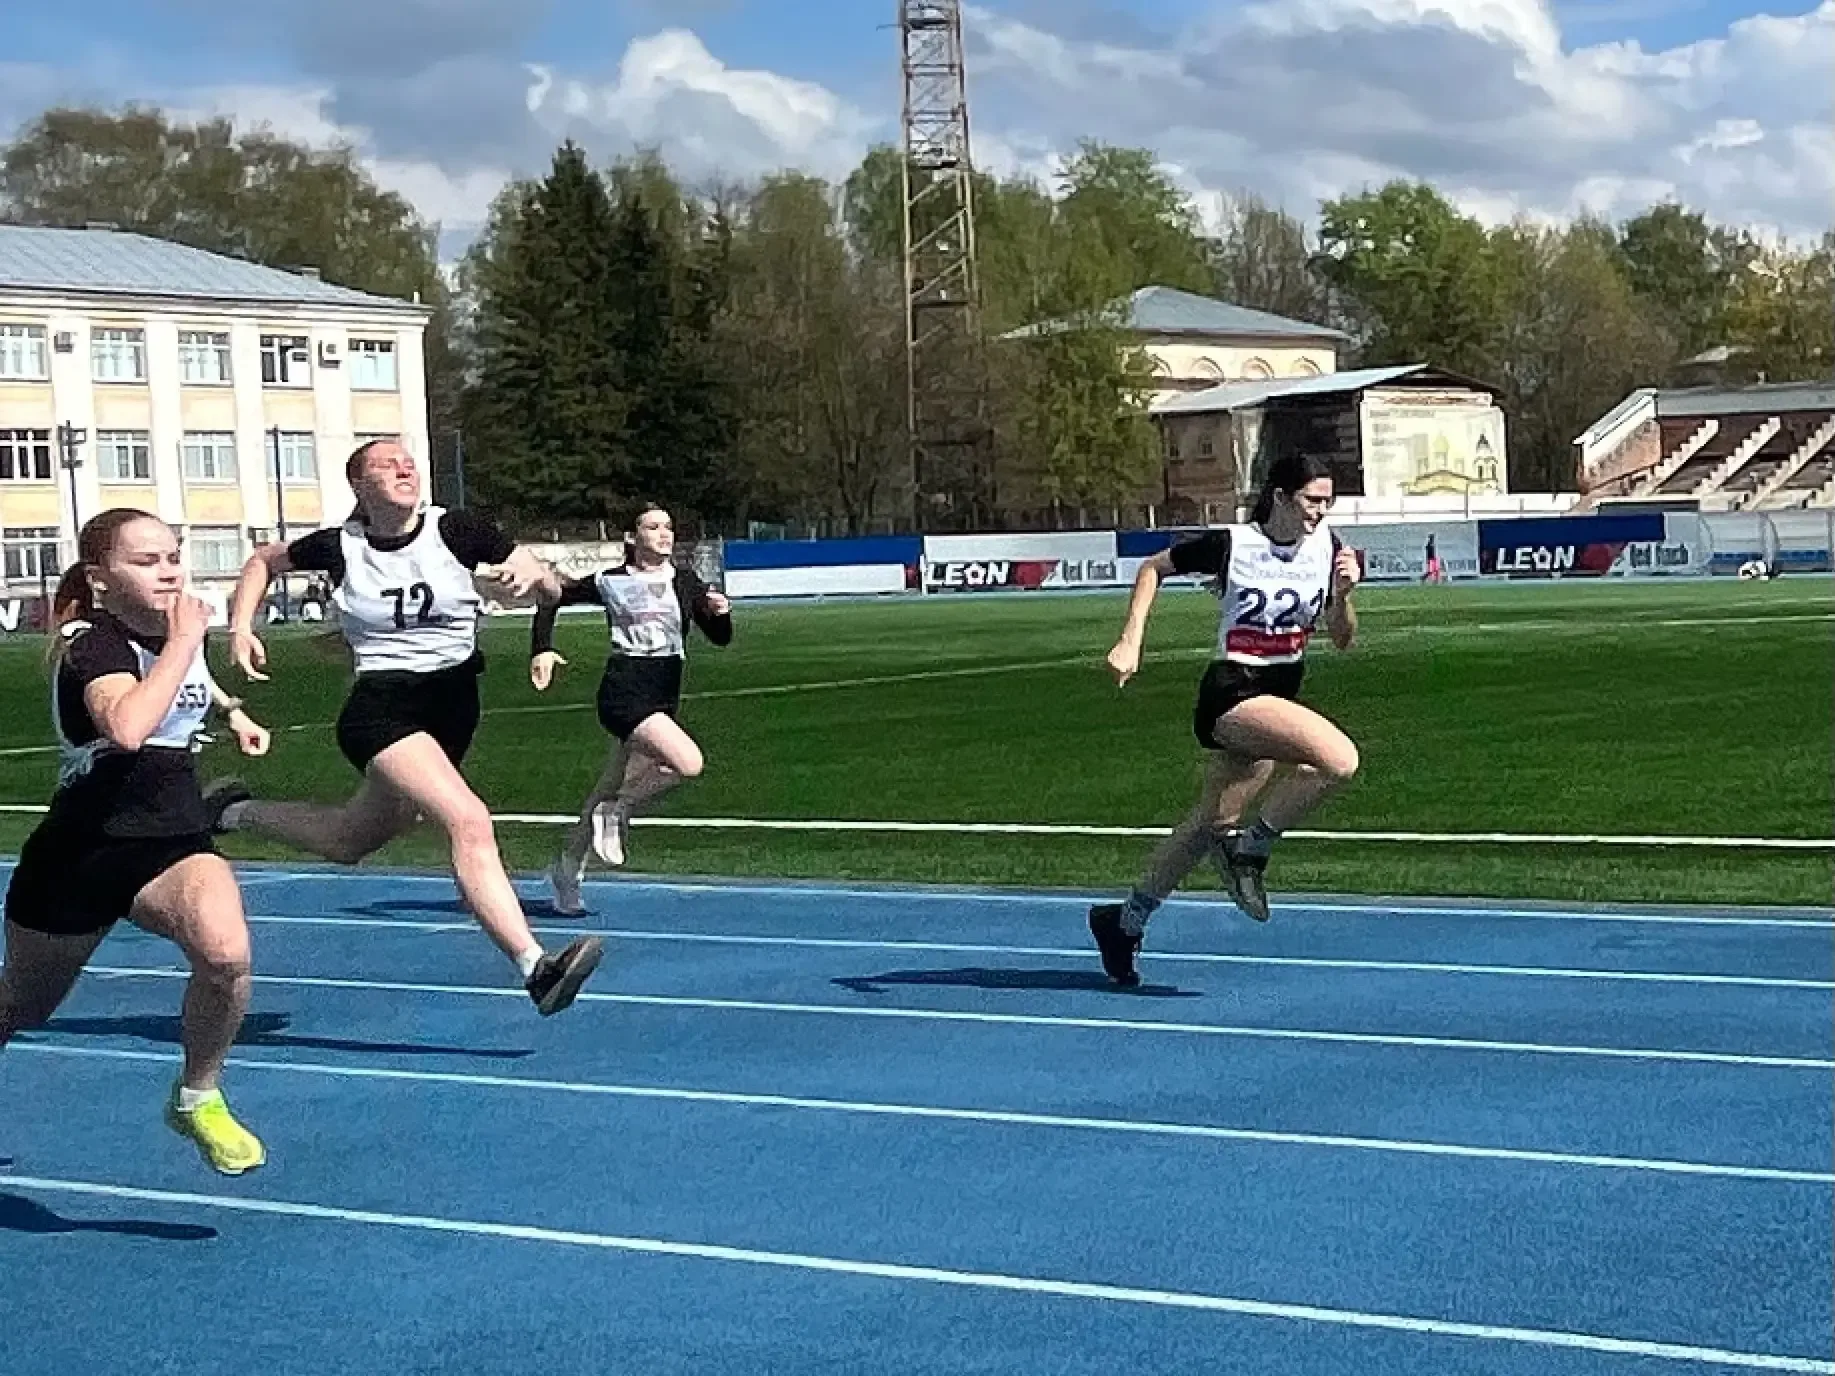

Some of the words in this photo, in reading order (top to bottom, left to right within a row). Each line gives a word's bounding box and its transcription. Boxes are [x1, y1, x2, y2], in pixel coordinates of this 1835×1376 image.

[1496, 545, 1575, 570] LEON
[926, 561, 1009, 585] LEON
[380, 581, 442, 629] 72
